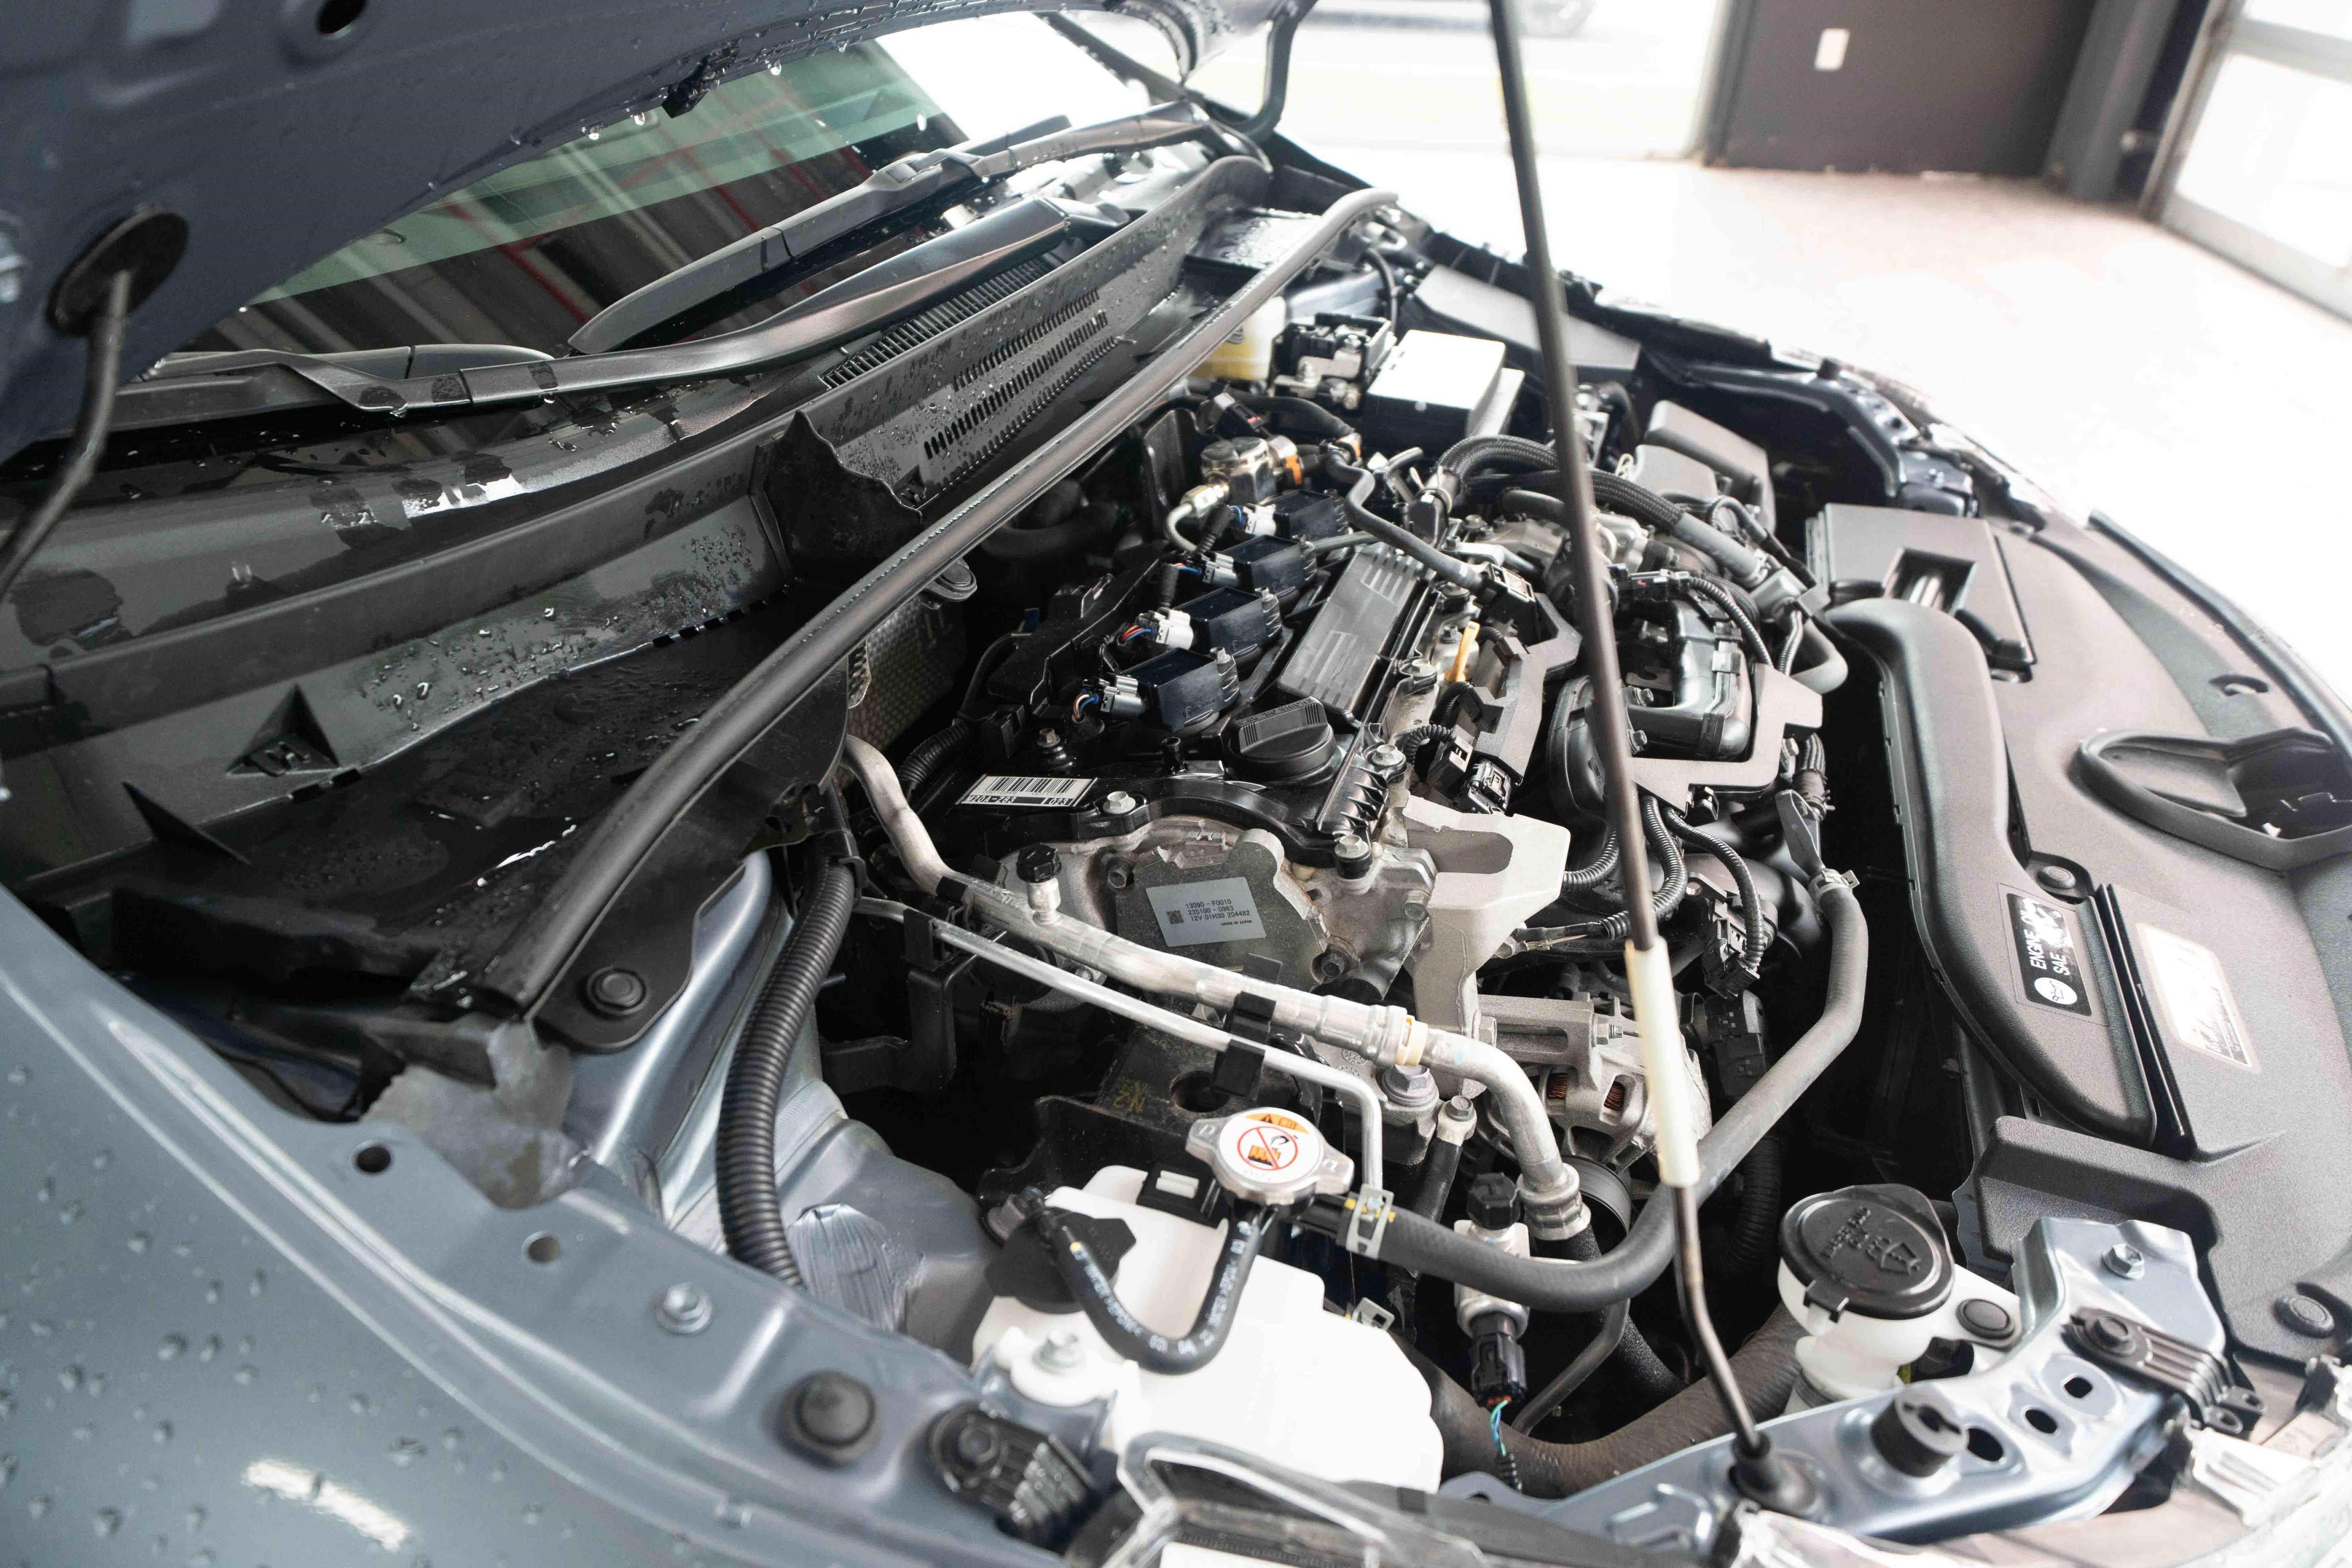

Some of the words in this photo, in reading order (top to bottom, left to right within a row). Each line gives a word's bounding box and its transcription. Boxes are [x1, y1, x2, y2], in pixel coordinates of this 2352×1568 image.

[1278, 697, 1315, 712] ENGINE
[1227, 910, 1251, 918] 204482
[2024, 929, 2047, 970] ENGINE
[2049, 952, 2070, 976] SAE
